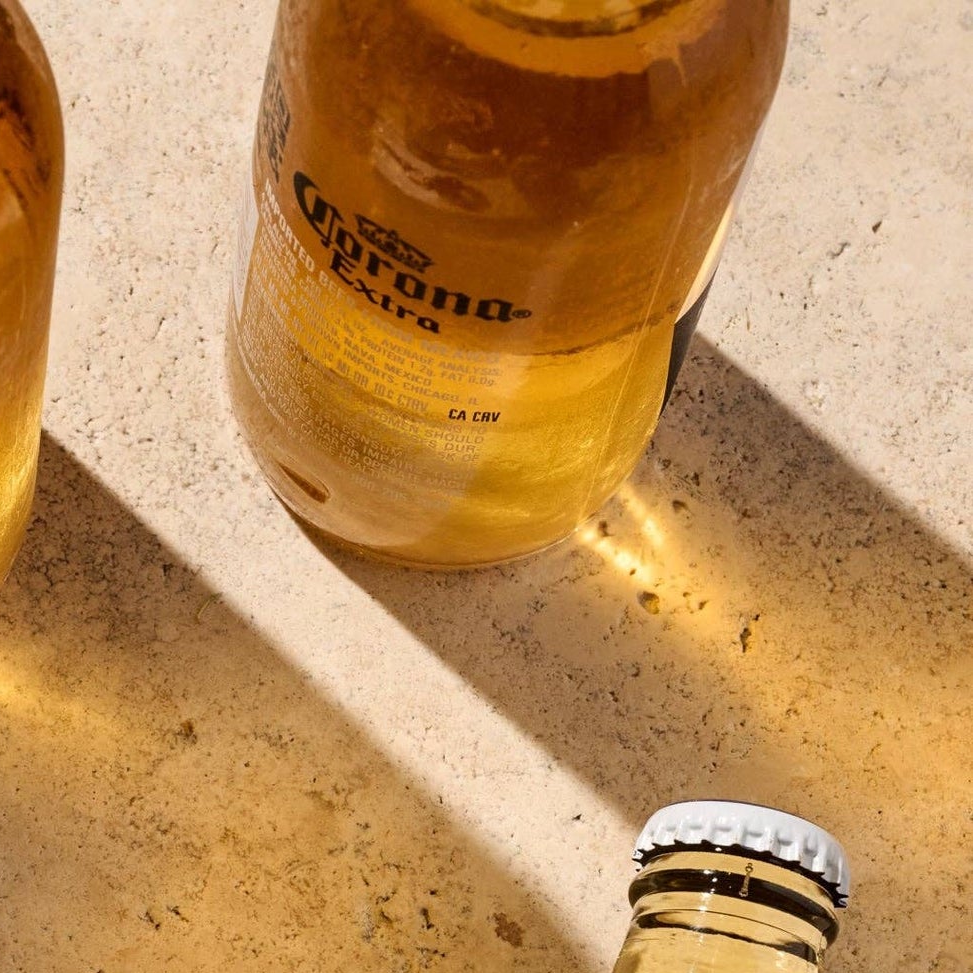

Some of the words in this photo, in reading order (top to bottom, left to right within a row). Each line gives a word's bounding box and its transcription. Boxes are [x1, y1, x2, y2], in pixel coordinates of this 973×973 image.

[330, 249, 440, 334] Extra
[383, 362, 432, 388] MEXICO
[448, 408, 467, 422] CA
[472, 410, 502, 424] CRV
[425, 427, 485, 445] SHOULD
